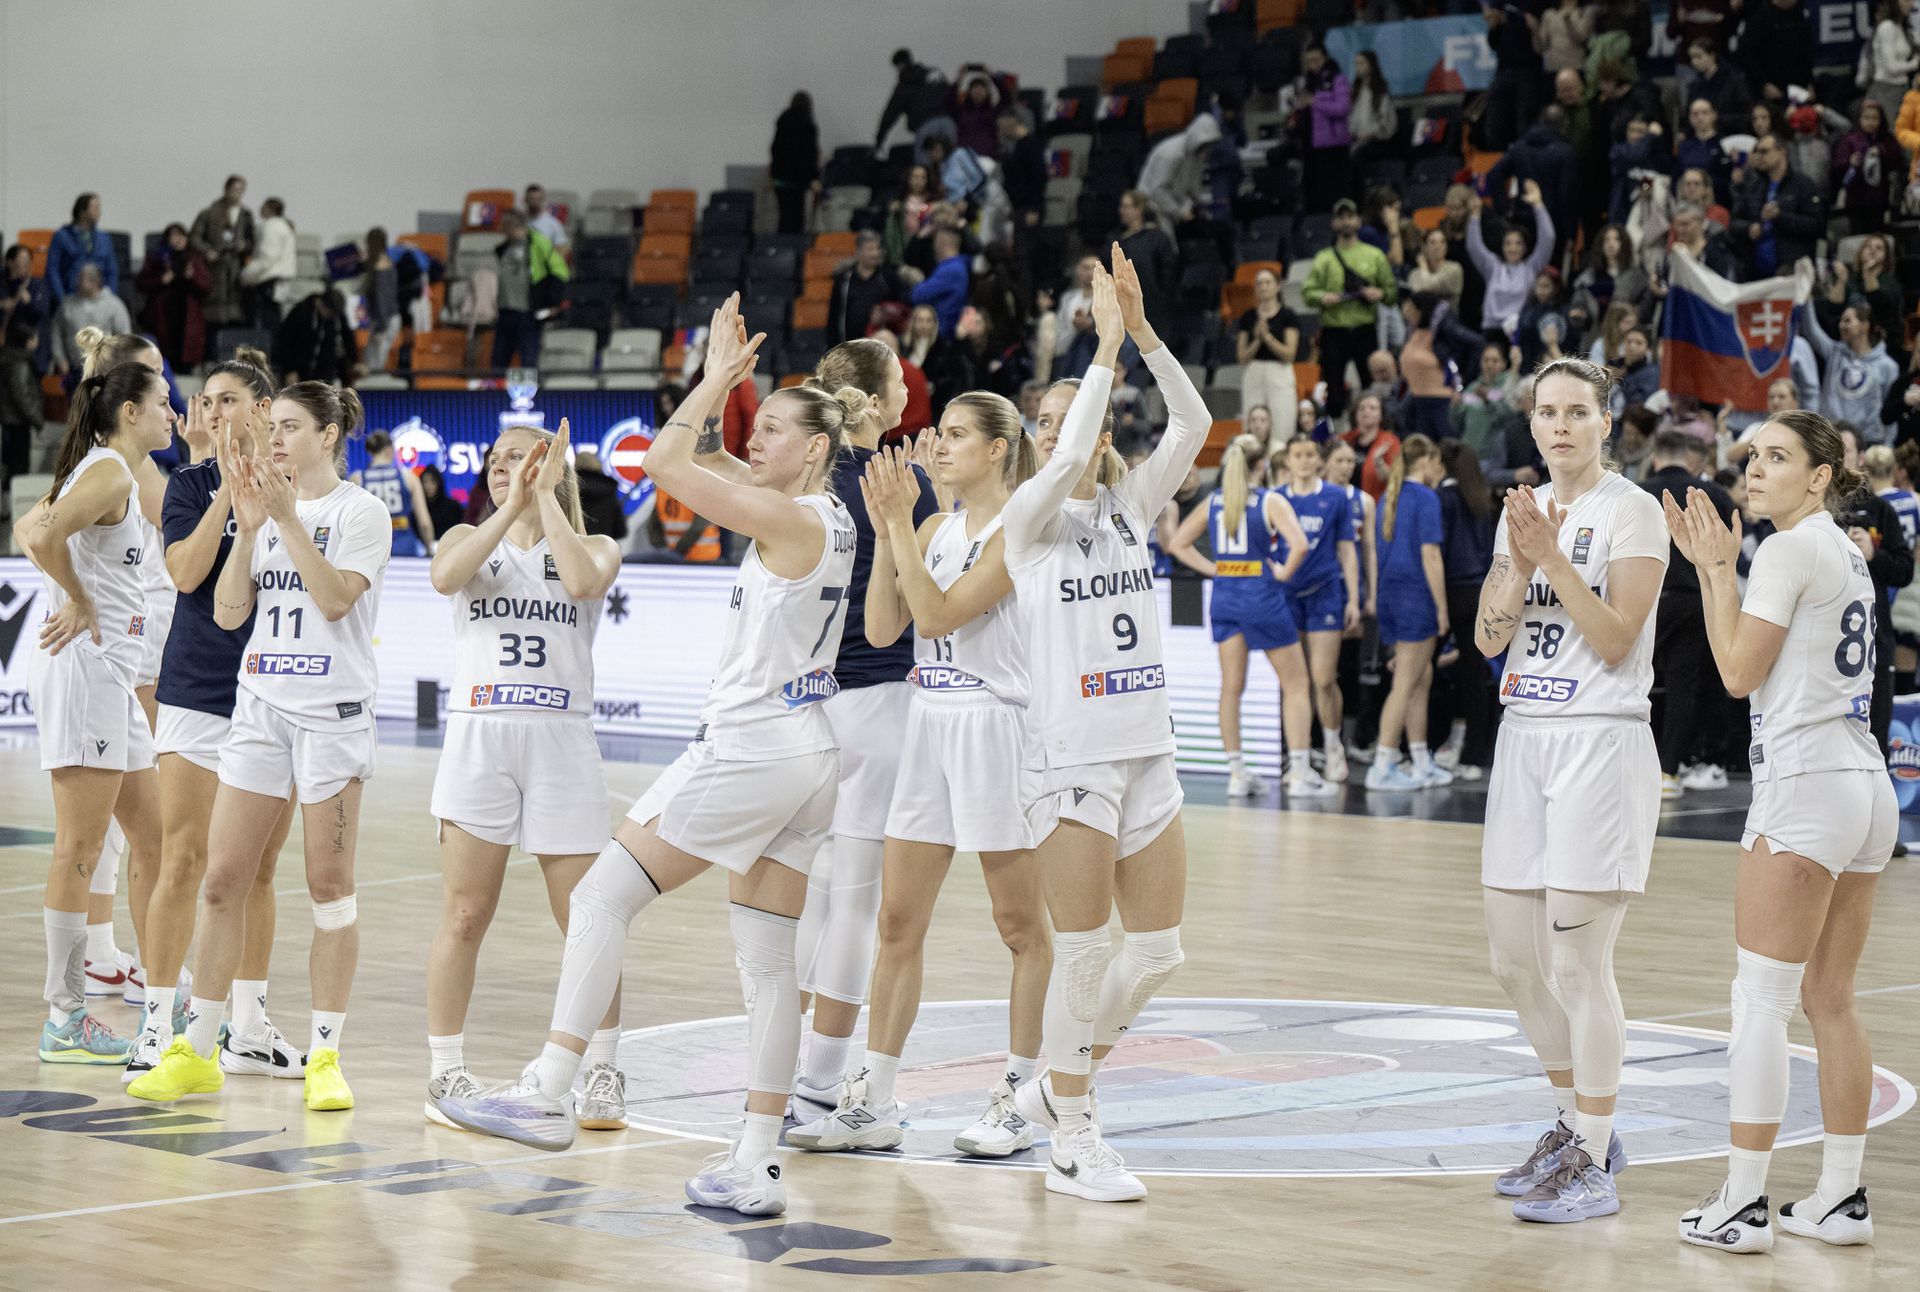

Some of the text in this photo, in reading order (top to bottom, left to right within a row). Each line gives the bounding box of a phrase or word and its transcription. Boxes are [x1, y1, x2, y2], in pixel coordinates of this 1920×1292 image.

[449, 442, 490, 475] SV
[469, 597, 577, 628] SLOVAKIA
[730, 585, 743, 611] IA
[267, 605, 304, 639] 11
[810, 585, 850, 659] 7
[1112, 613, 1138, 651] 9
[499, 633, 547, 668] 33
[1525, 621, 1565, 660] 38
[263, 656, 326, 674] TIPOS
[921, 668, 980, 687] TIPOS
[1111, 669, 1165, 691] TIPOS
[498, 686, 567, 708] TIPOS
